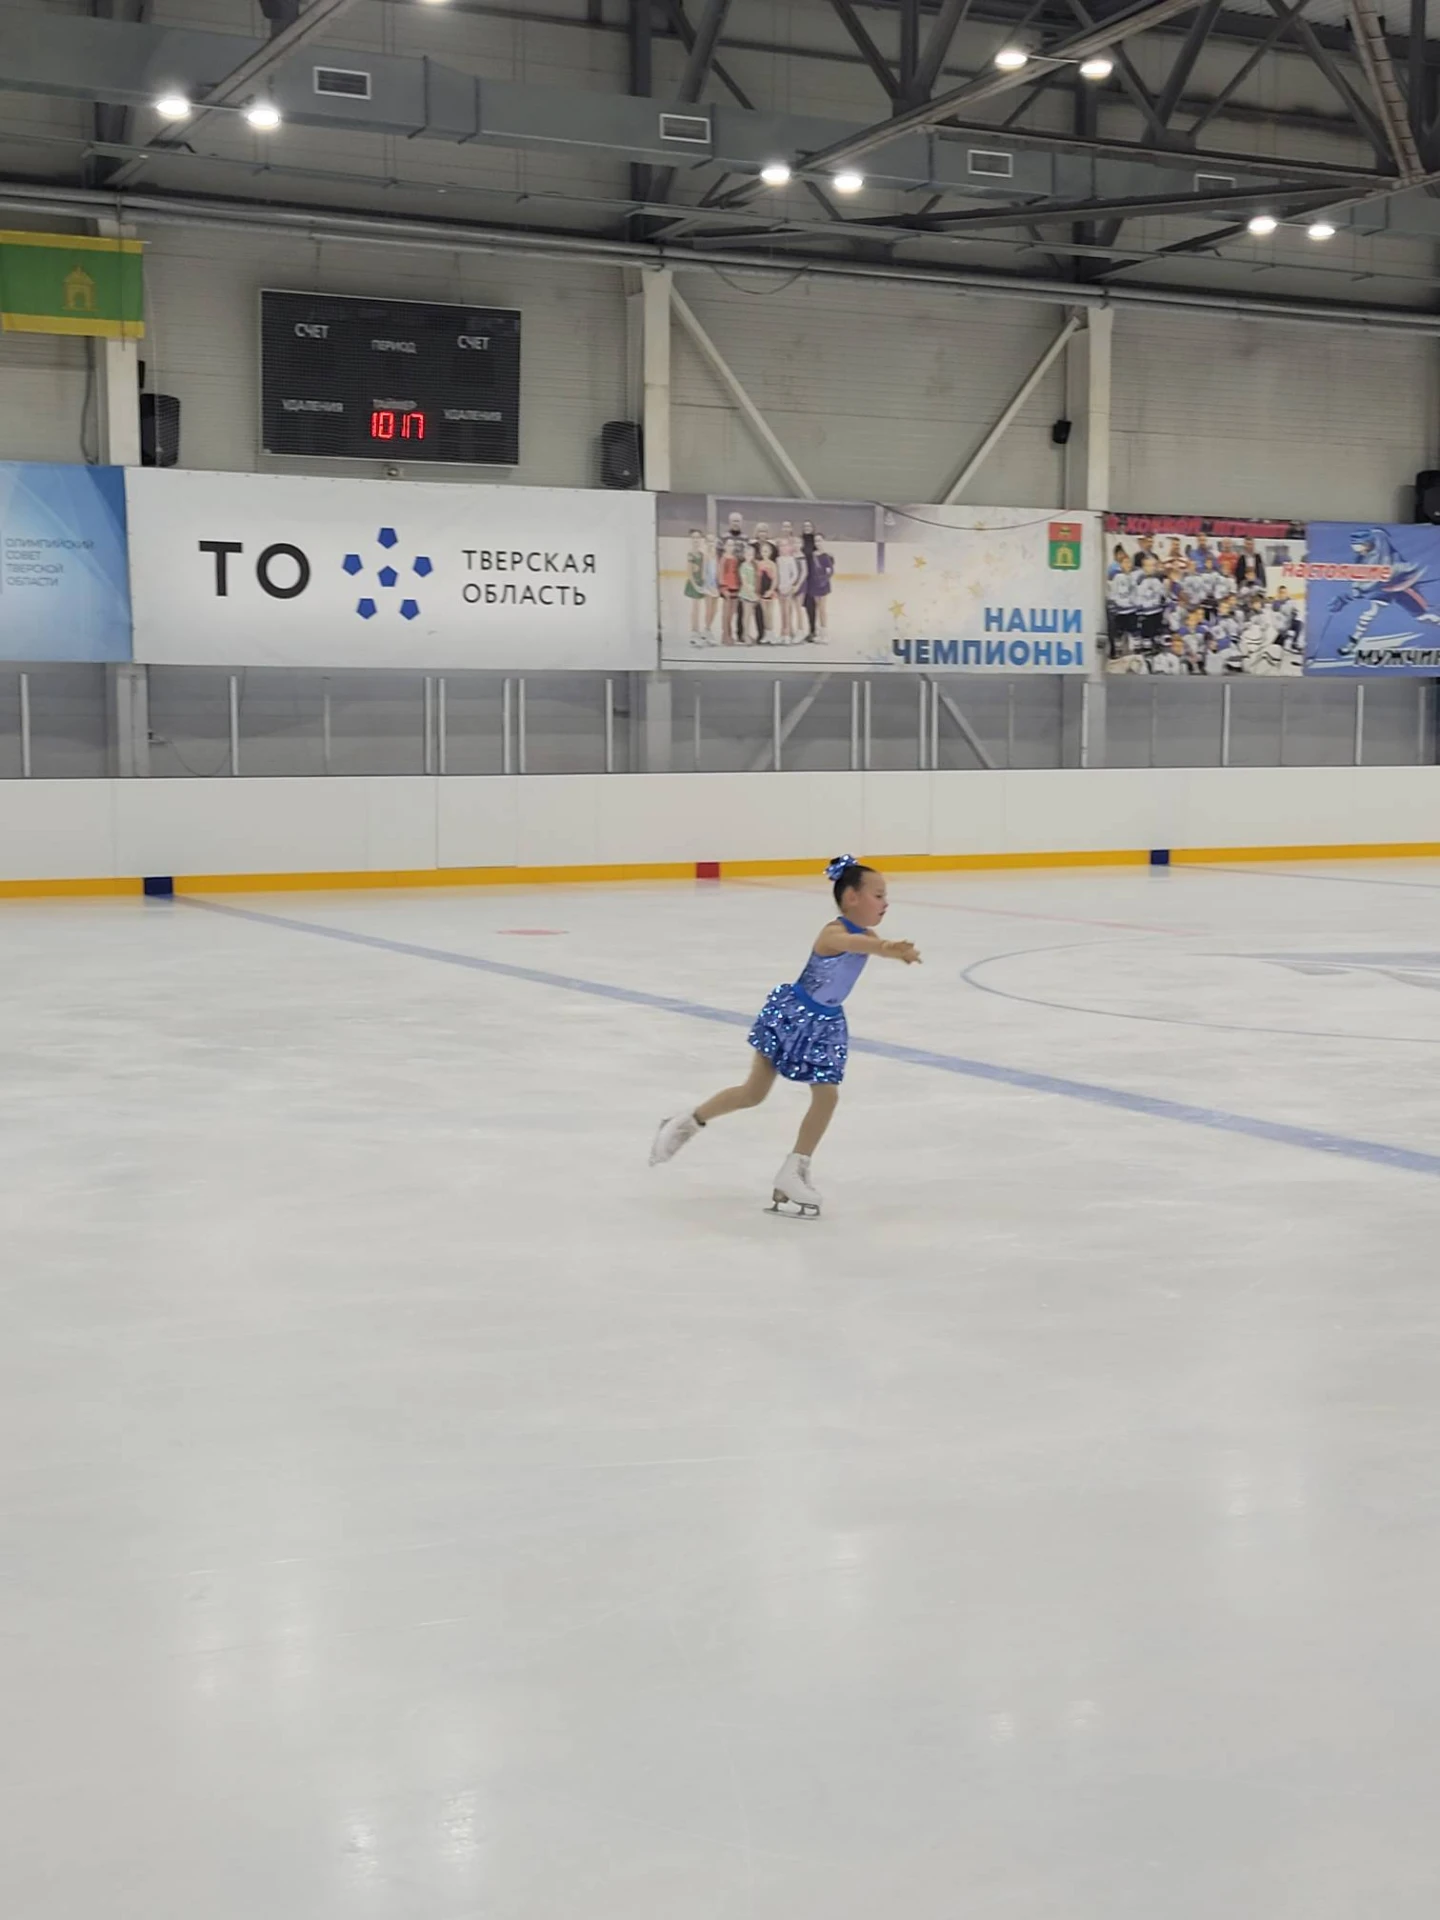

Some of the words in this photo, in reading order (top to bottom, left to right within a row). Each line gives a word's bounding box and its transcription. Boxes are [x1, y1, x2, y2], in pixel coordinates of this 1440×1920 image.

[294, 323, 330, 339] СЧЕТ
[371, 340, 417, 354] ПЕРИОД
[457, 335, 491, 351] СЧЕТ
[282, 399, 344, 413] УДАЛЕНИЯ
[5, 550, 41, 561] СОВЕТ
[461, 549, 596, 574] ТВЕРСКАЯ
[5, 562, 64, 574] ТВЕРСКОЙ
[198, 540, 312, 600] ТО
[5, 575, 59, 587] ОБЛАСТИ
[461, 583, 587, 606] ОБЛАСТЬ
[984, 606, 1083, 634] НАШИ
[891, 638, 1083, 667] ЧЕМПИОНЫ
